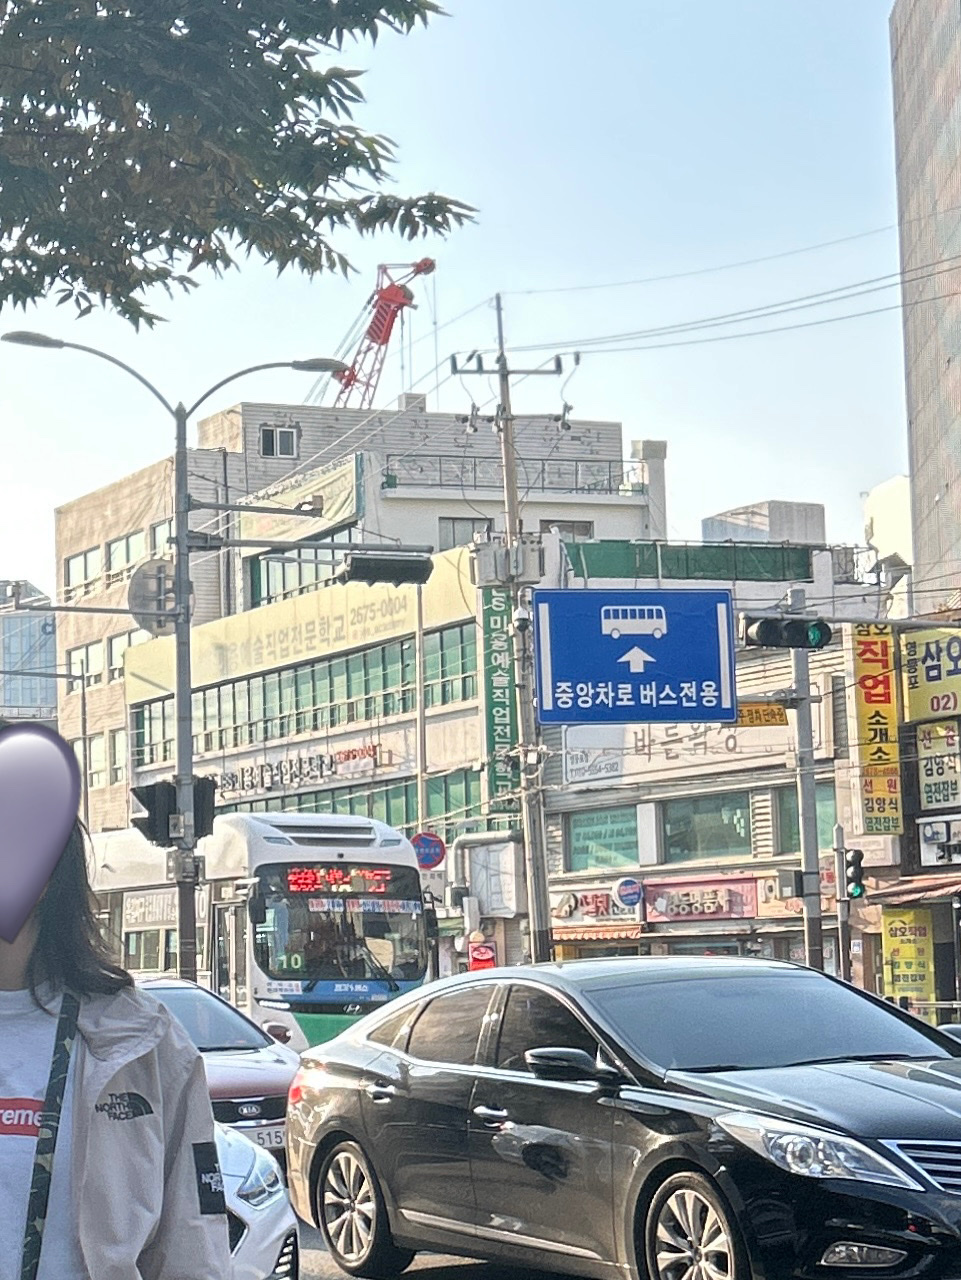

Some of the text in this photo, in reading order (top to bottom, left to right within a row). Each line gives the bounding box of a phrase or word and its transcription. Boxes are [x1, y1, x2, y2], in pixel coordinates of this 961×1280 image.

[856, 640, 892, 704] 직업
[906, 641, 919, 690] 영등포
[554, 680, 720, 709] 중앙차로 버스전용
[930, 691, 958, 712] 02)
[867, 710, 891, 766] 소개소
[864, 797, 899, 813] 김양식
[279, 953, 302, 969] 10
[108, 1092, 129, 1103] THE
[95, 1101, 131, 1114] NORTH
[240, 1105, 257, 1115] KIA
[108, 1112, 135, 1121] FACE
[256, 1130, 285, 1146] 515
